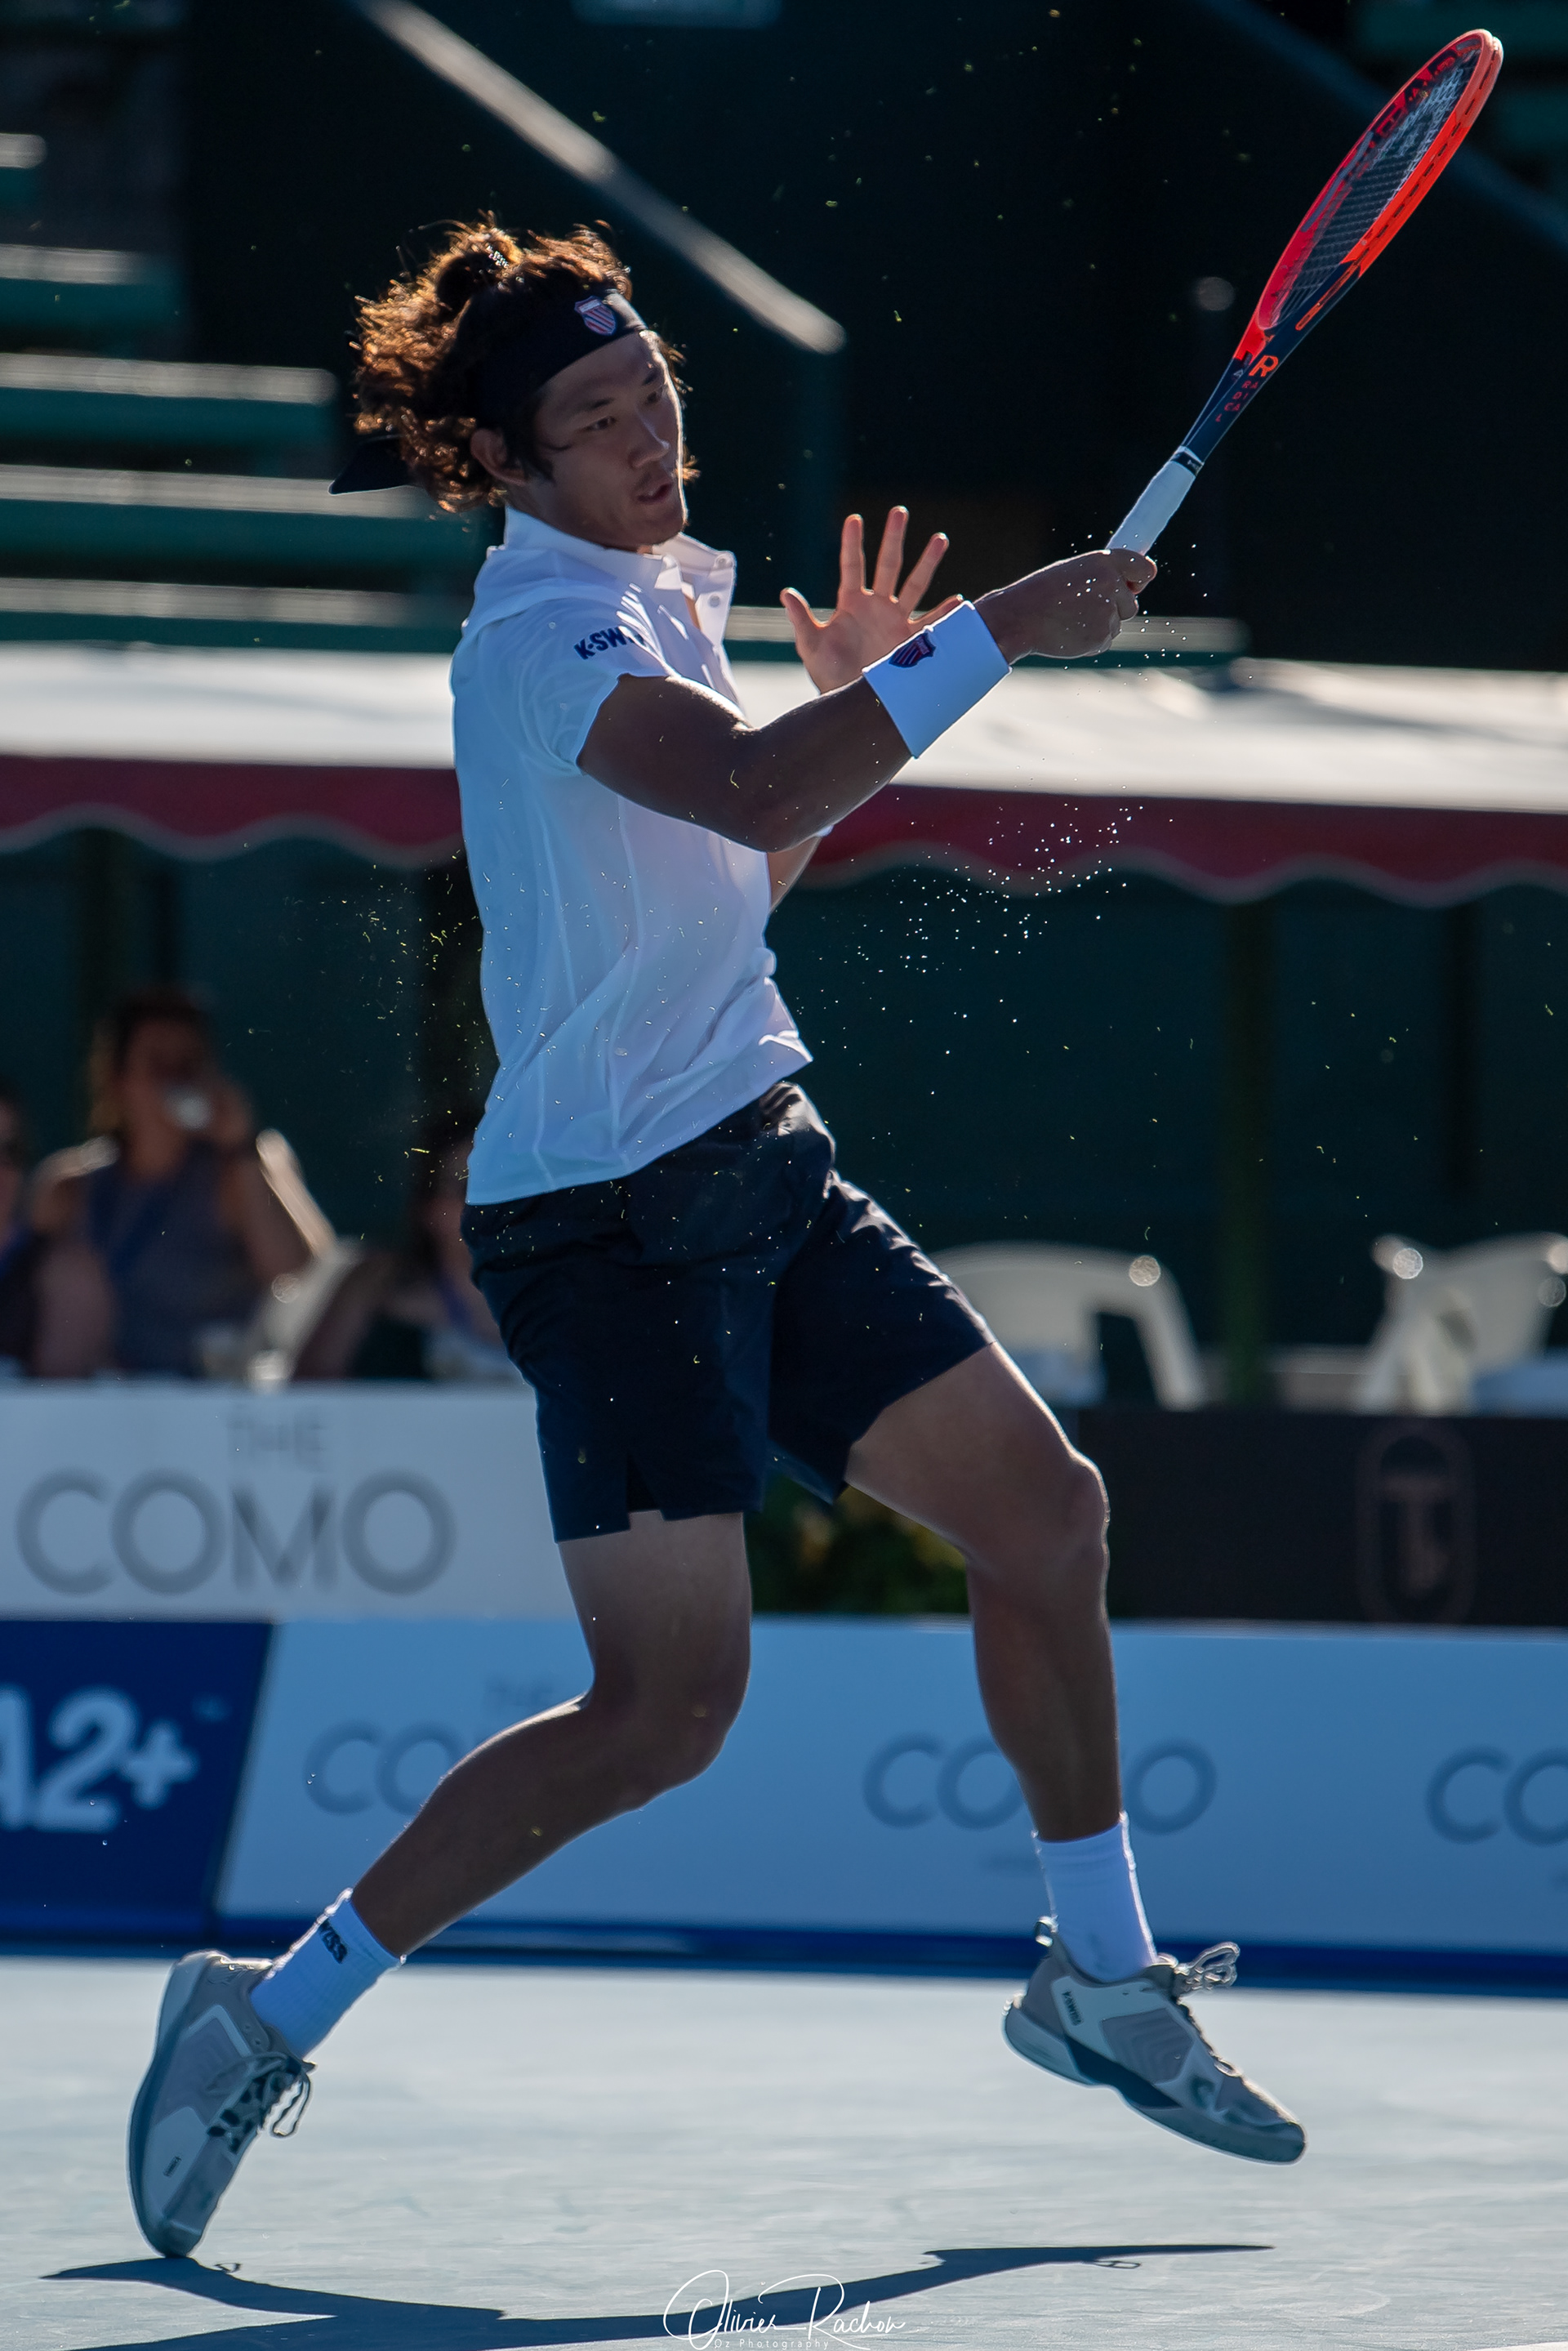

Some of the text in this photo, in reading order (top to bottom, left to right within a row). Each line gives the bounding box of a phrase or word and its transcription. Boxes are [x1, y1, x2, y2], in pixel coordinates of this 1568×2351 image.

[1249, 355, 1279, 377] R
[15, 1469, 456, 1596] COMO
[304, 1717, 498, 1817] CO
[862, 1733, 1216, 1836] COO
